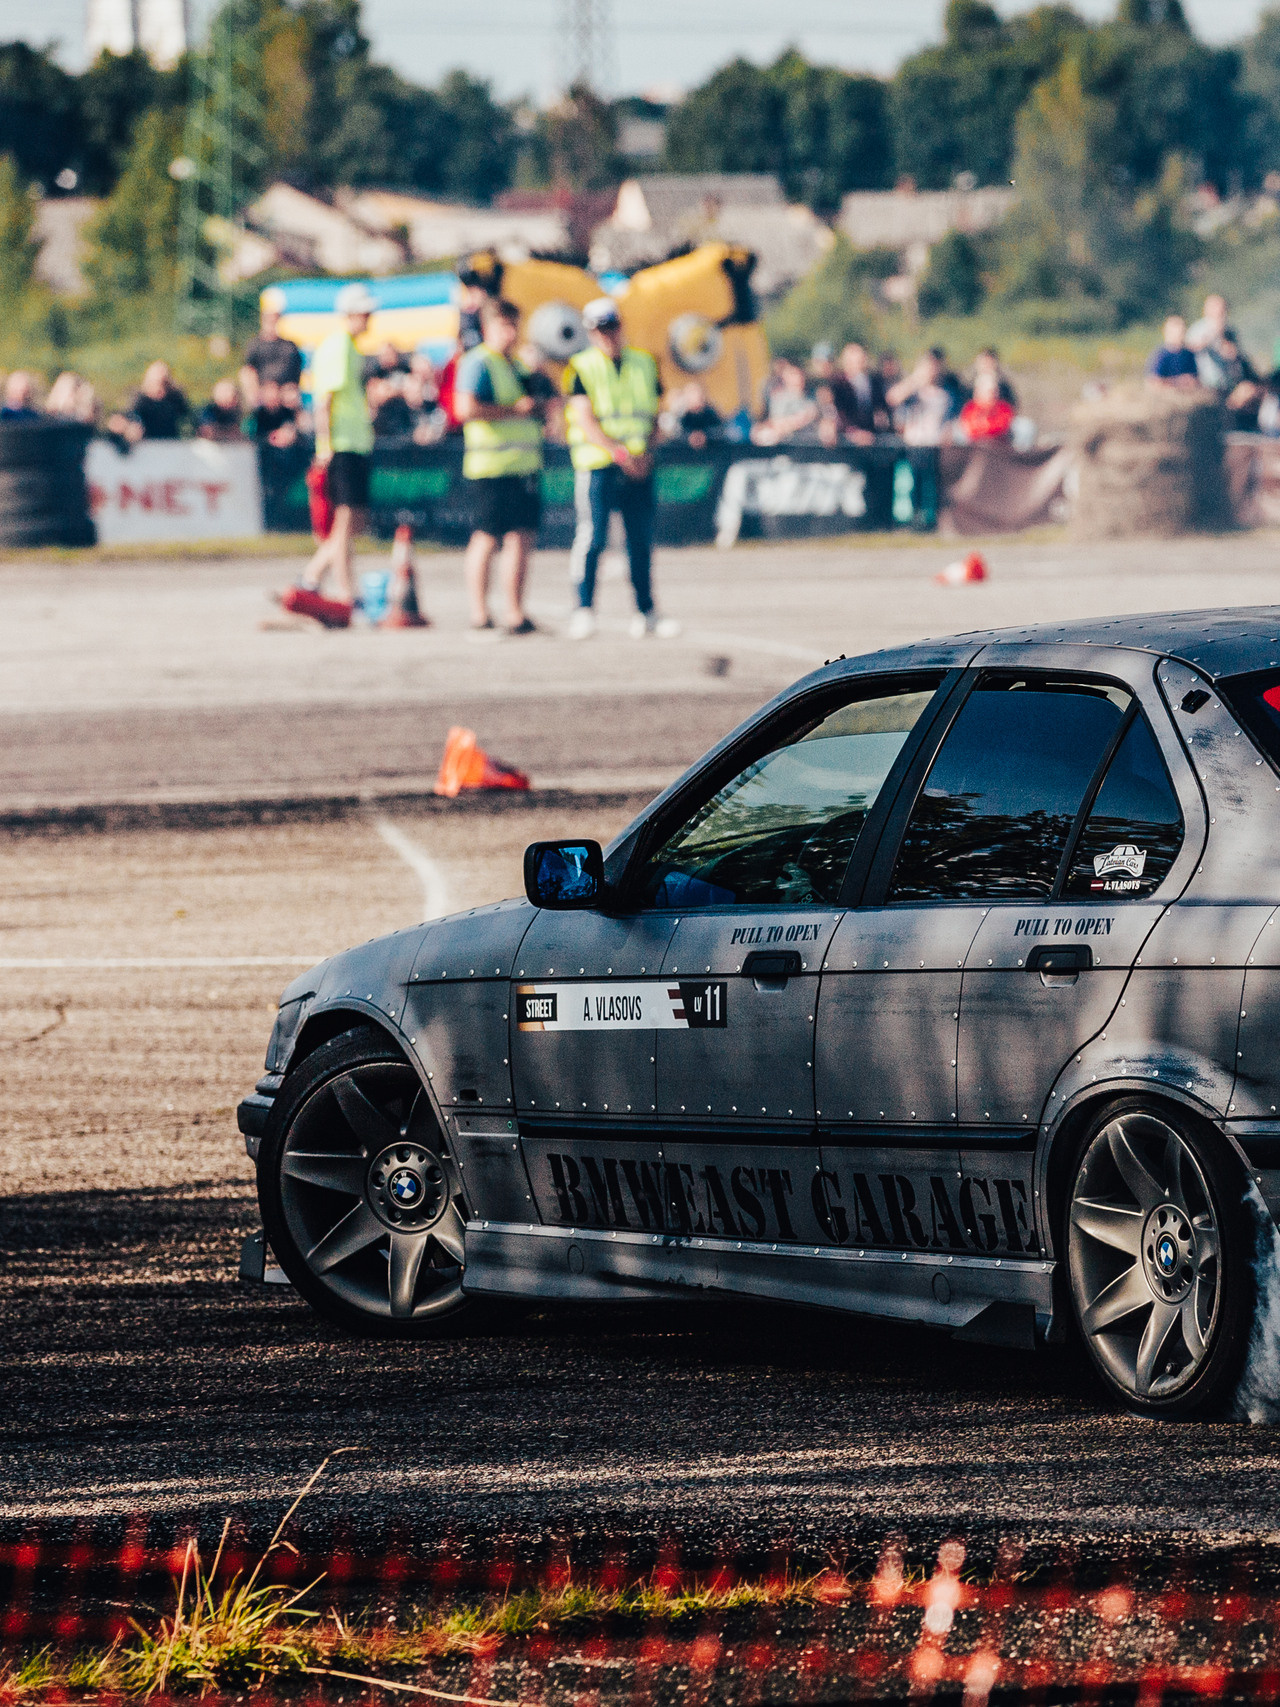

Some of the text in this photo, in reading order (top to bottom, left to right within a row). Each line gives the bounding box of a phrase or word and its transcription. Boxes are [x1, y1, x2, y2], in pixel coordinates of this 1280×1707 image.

[730, 924, 822, 944] PULL TO OPEN
[1013, 918, 1115, 936] PULL TO OPEN
[526, 998, 553, 1018] STREET
[583, 996, 642, 1021] A. VLASOVS
[694, 985, 720, 1021] LV 11
[547, 1152, 1039, 1253] BMWEAST GARAGE
